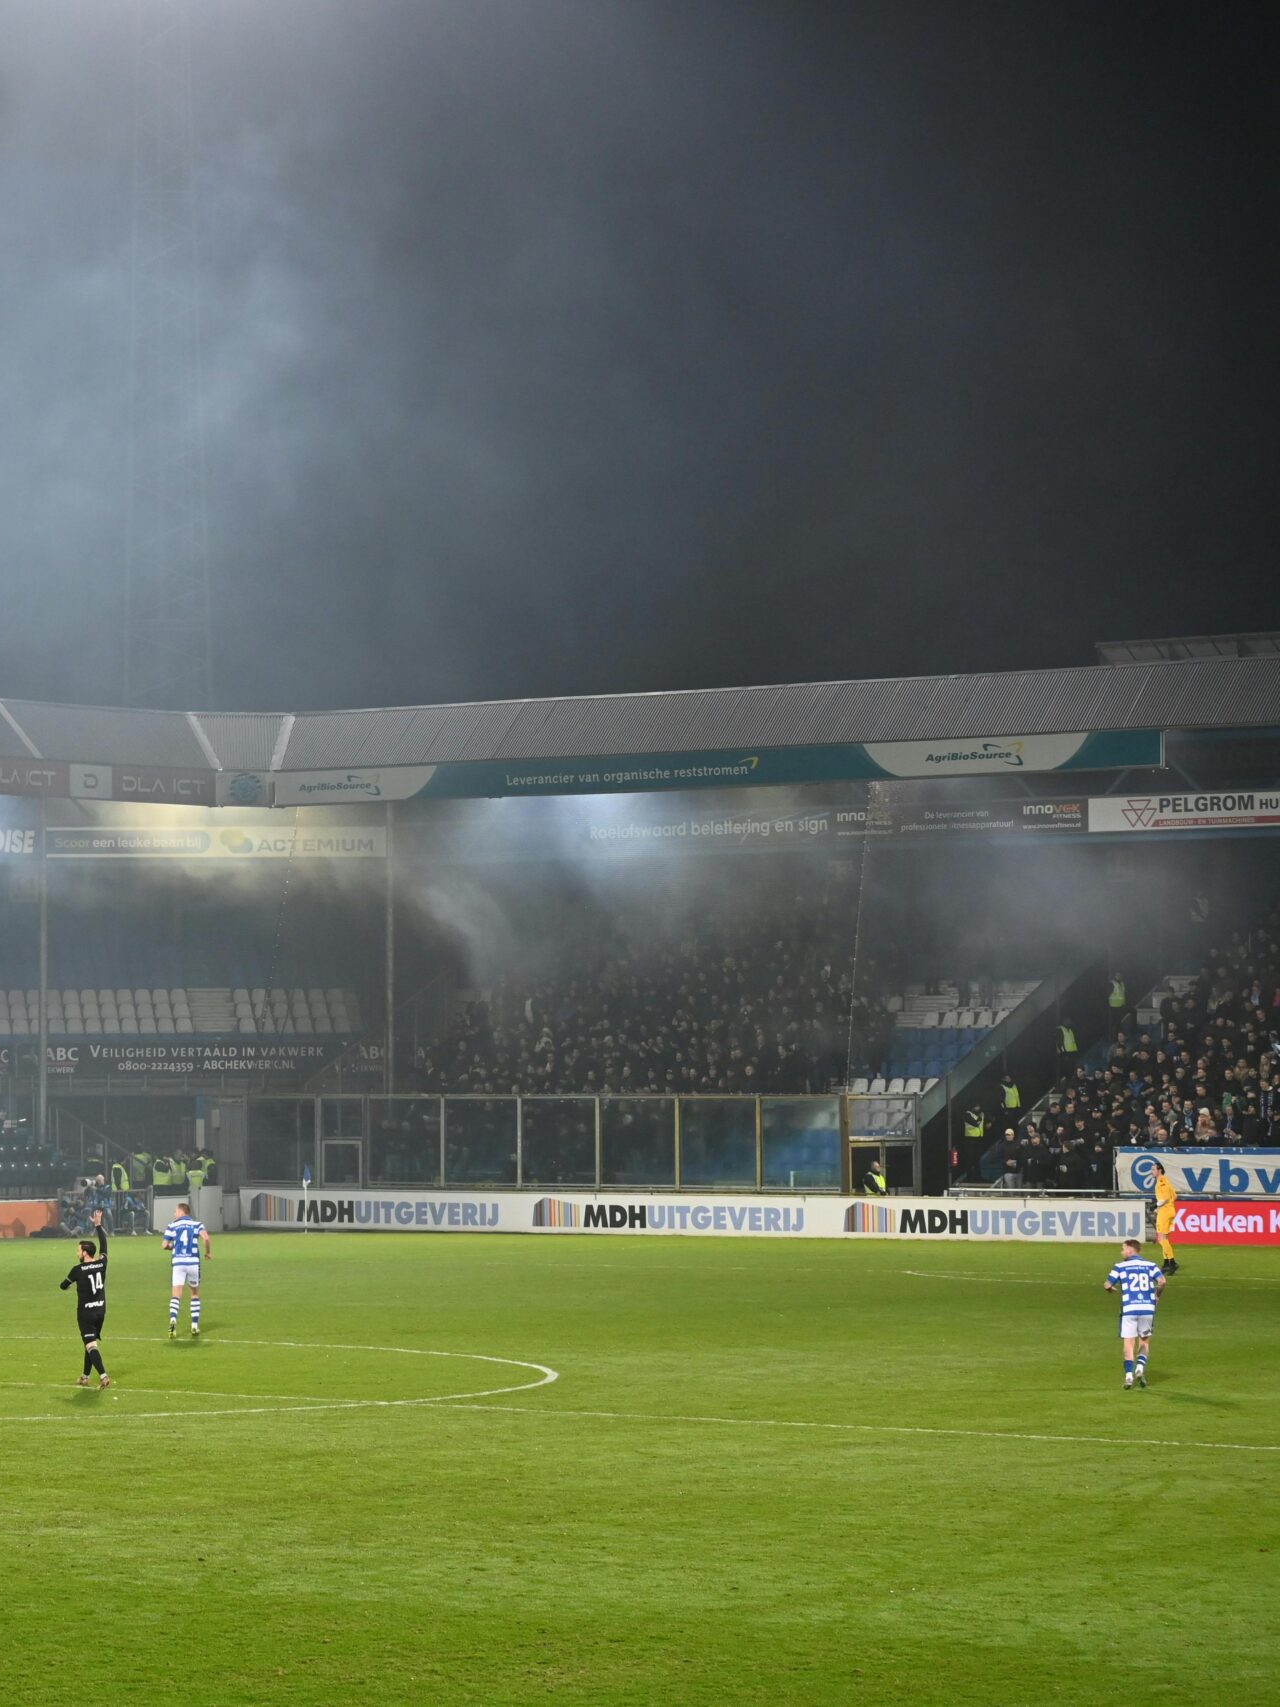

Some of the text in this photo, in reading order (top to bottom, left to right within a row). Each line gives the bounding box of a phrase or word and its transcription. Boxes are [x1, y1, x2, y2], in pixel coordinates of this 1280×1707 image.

[924, 751, 1012, 764] AgriBioSource
[25, 770, 56, 786] ICT
[83, 774, 98, 789] D
[506, 764, 748, 786] Leverancier van organische reststromen
[122, 775, 206, 794] DLA ICT
[298, 782, 372, 793] AgriBioSource
[1158, 794, 1254, 813] PELGROM
[924, 811, 935, 820] De
[975, 809, 989, 817] van
[691, 818, 770, 837] belettering
[775, 820, 794, 832] en
[798, 816, 828, 835] sign
[950, 820, 1014, 830] itnessapparatuur!
[55, 837, 202, 849] Scoor een leuke baan bij
[257, 839, 374, 853] ACTEMIUM
[46, 1047, 79, 1062] ABC
[89, 1044, 324, 1058] VEILIGHEID VERTAALD IN VAKWERK
[117, 1060, 194, 1072] 0800-2224359
[203, 1059, 296, 1070] ABCHEKWERK.NL
[1181, 1159, 1280, 1194] vbv
[1171, 1208, 1264, 1233] Keuken
[180, 1229, 189, 1246] 4
[88, 1271, 104, 1295] 14
[1128, 1272, 1149, 1292] 28
